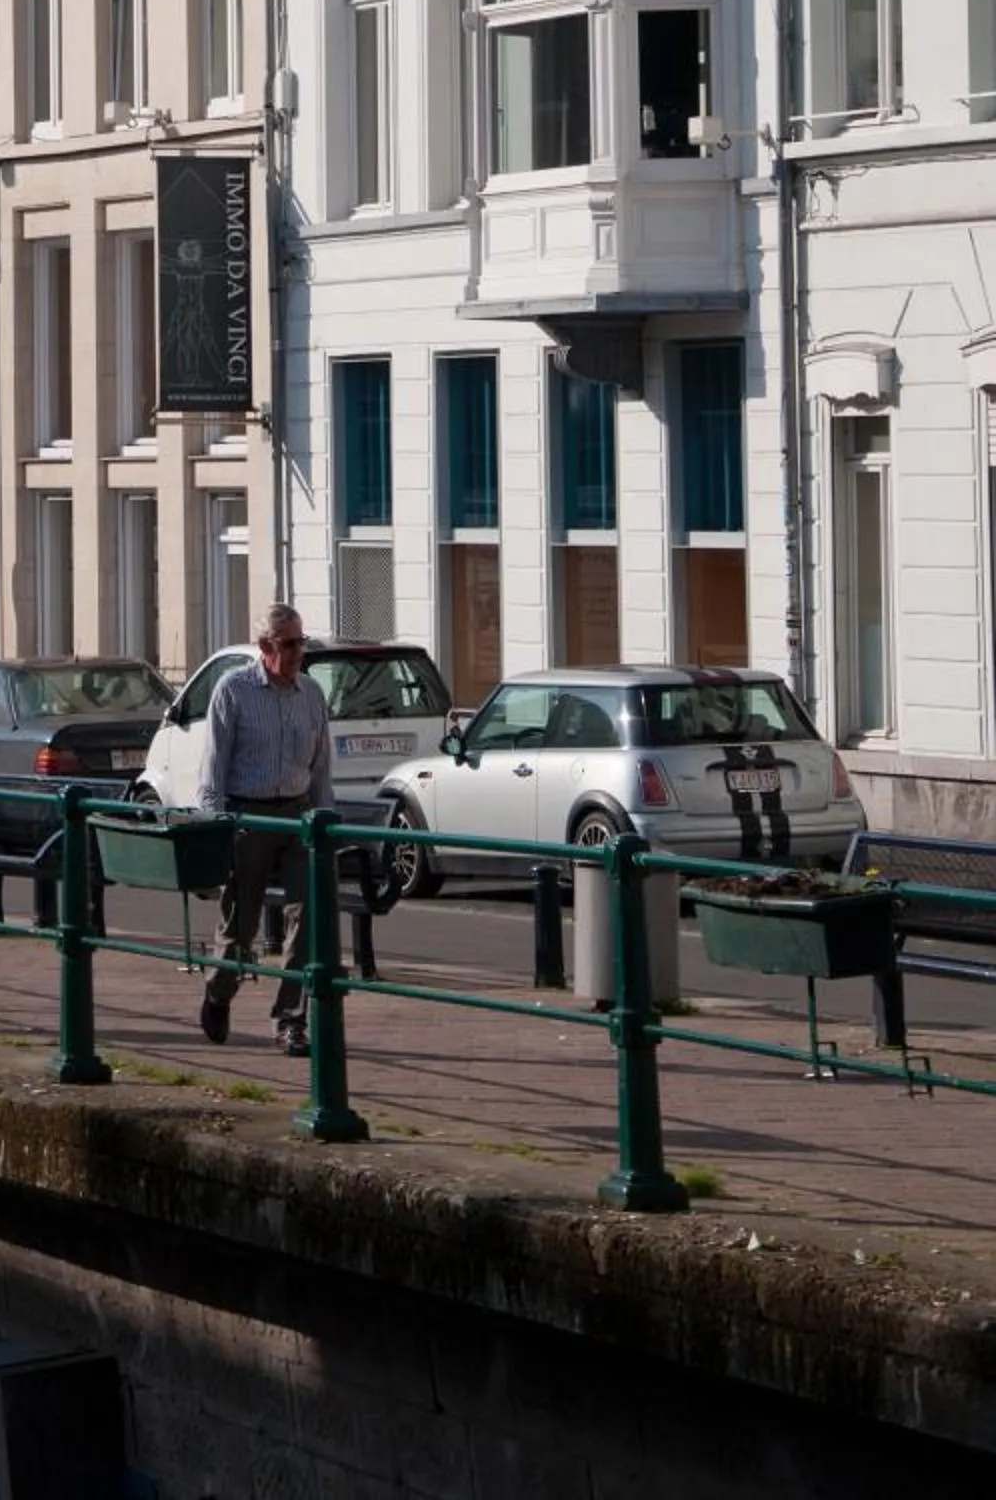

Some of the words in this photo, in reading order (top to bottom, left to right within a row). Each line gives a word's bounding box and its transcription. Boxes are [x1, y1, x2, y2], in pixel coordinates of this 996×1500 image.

[225, 171, 245, 251] IMMO
[227, 260, 245, 299] DA
[227, 306, 247, 384] VINCI
